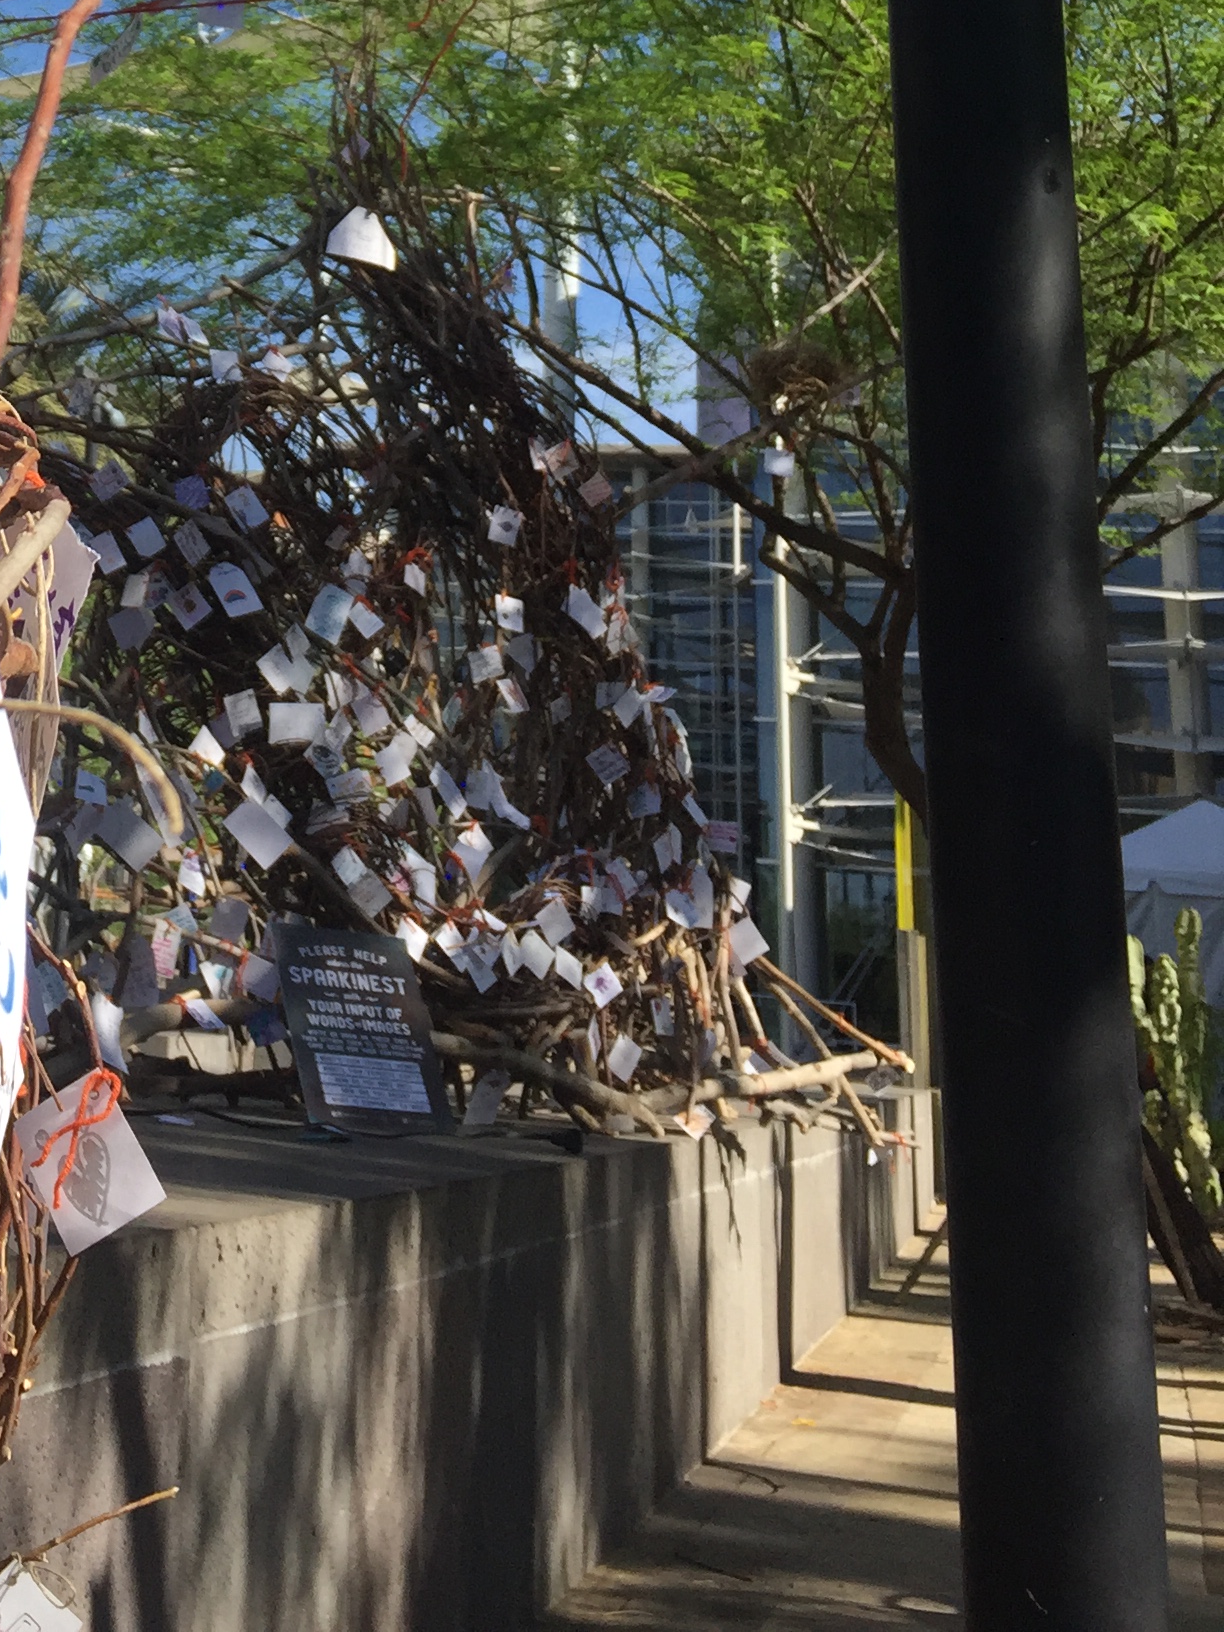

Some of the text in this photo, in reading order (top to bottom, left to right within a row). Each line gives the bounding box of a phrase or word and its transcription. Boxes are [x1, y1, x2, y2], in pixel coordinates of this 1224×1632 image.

[297, 945, 388, 965] PLEASE HELP
[288, 966, 405, 995] SPARK!NEST
[307, 999, 402, 1020] YOUR INPUT OF
[306, 1013, 411, 1036] WORDS IMAGES
